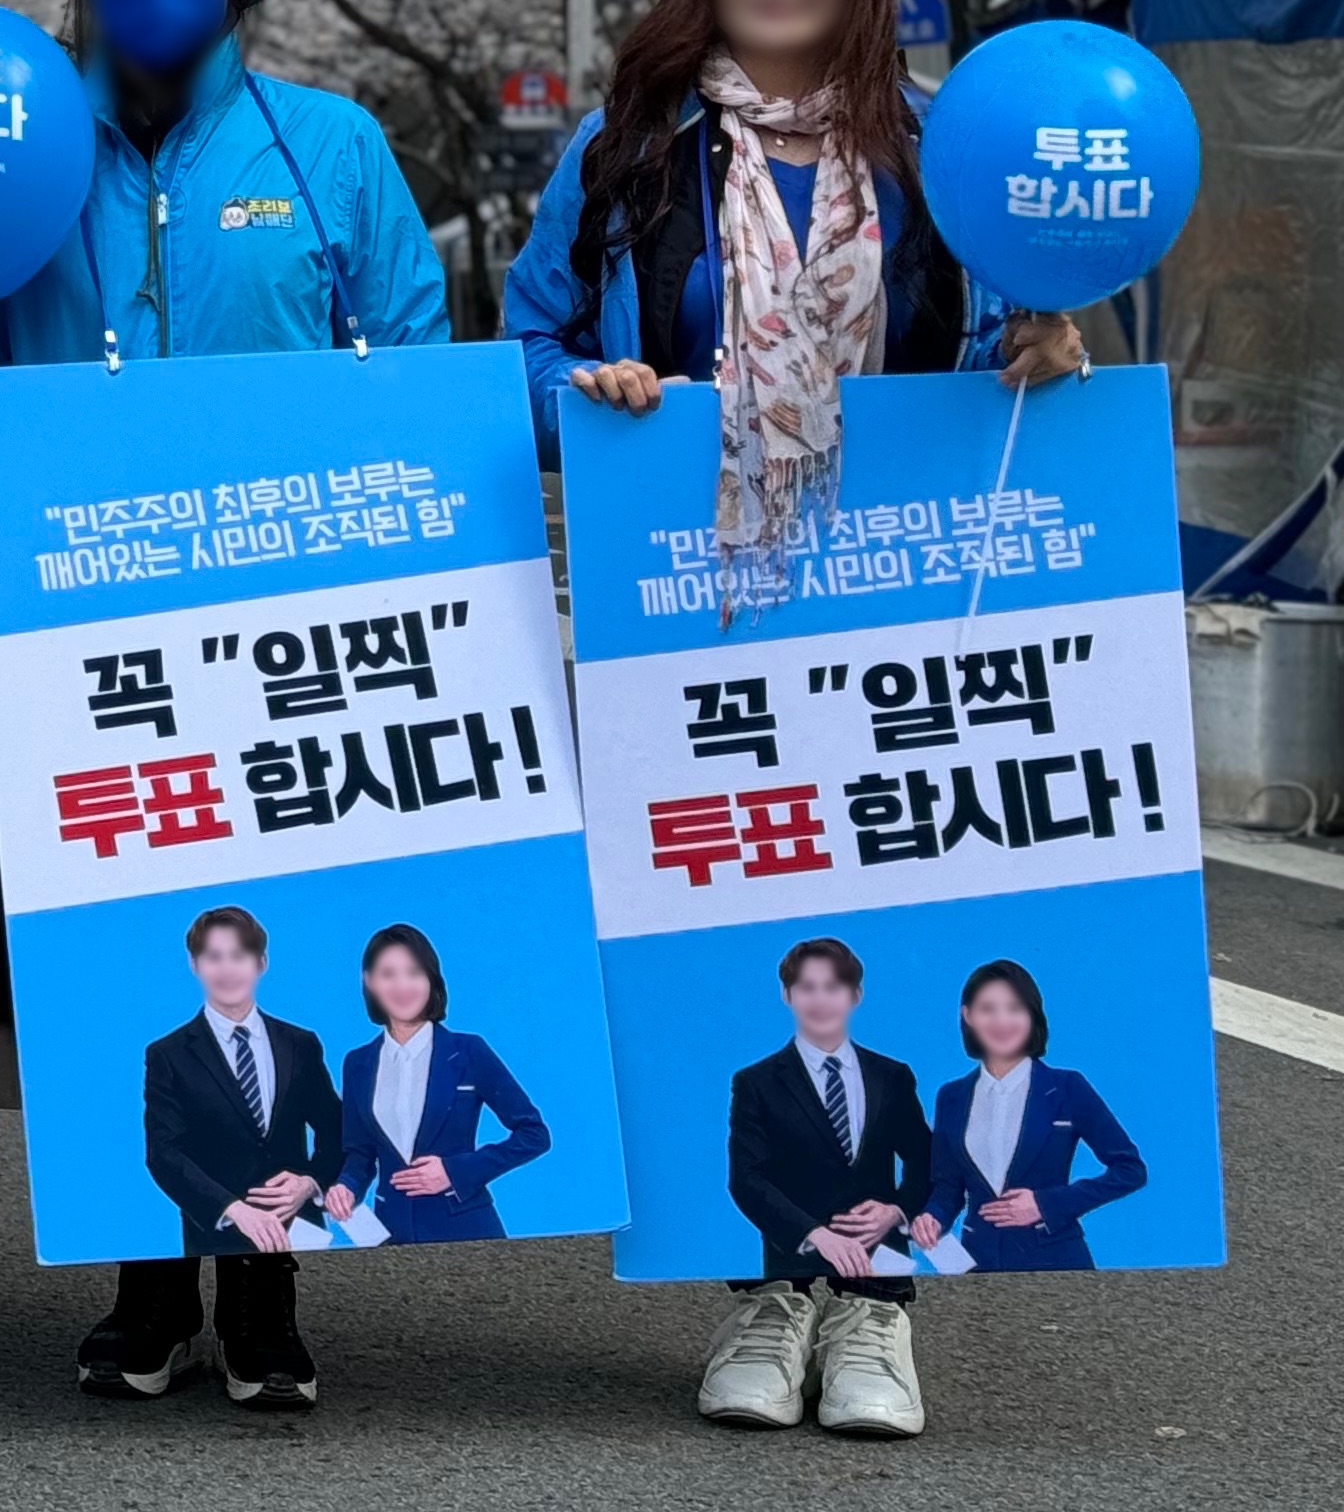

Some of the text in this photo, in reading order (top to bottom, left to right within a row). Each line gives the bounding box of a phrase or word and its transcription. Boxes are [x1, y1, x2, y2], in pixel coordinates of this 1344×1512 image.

[1033, 127, 1130, 171] 투표
[1006, 174, 1153, 221] 합시다
[36, 494, 466, 591] 깨어있는 시민의 조직된 힘"
[45, 460, 433, 546] "민주주의 최후의 보루는
[650, 489, 1062, 570] "민의 최후의 보루는
[800, 550, 910, 598] 시민의
[922, 537, 1033, 586] 조직된
[1047, 523, 1095, 570] 힘"
[83, 600, 469, 738] 꼭 "일찍"
[683, 634, 1093, 768] 꼭 "일찍"
[54, 705, 546, 859] 투표 합시다!
[647, 743, 1165, 886] 투표 합시다!
